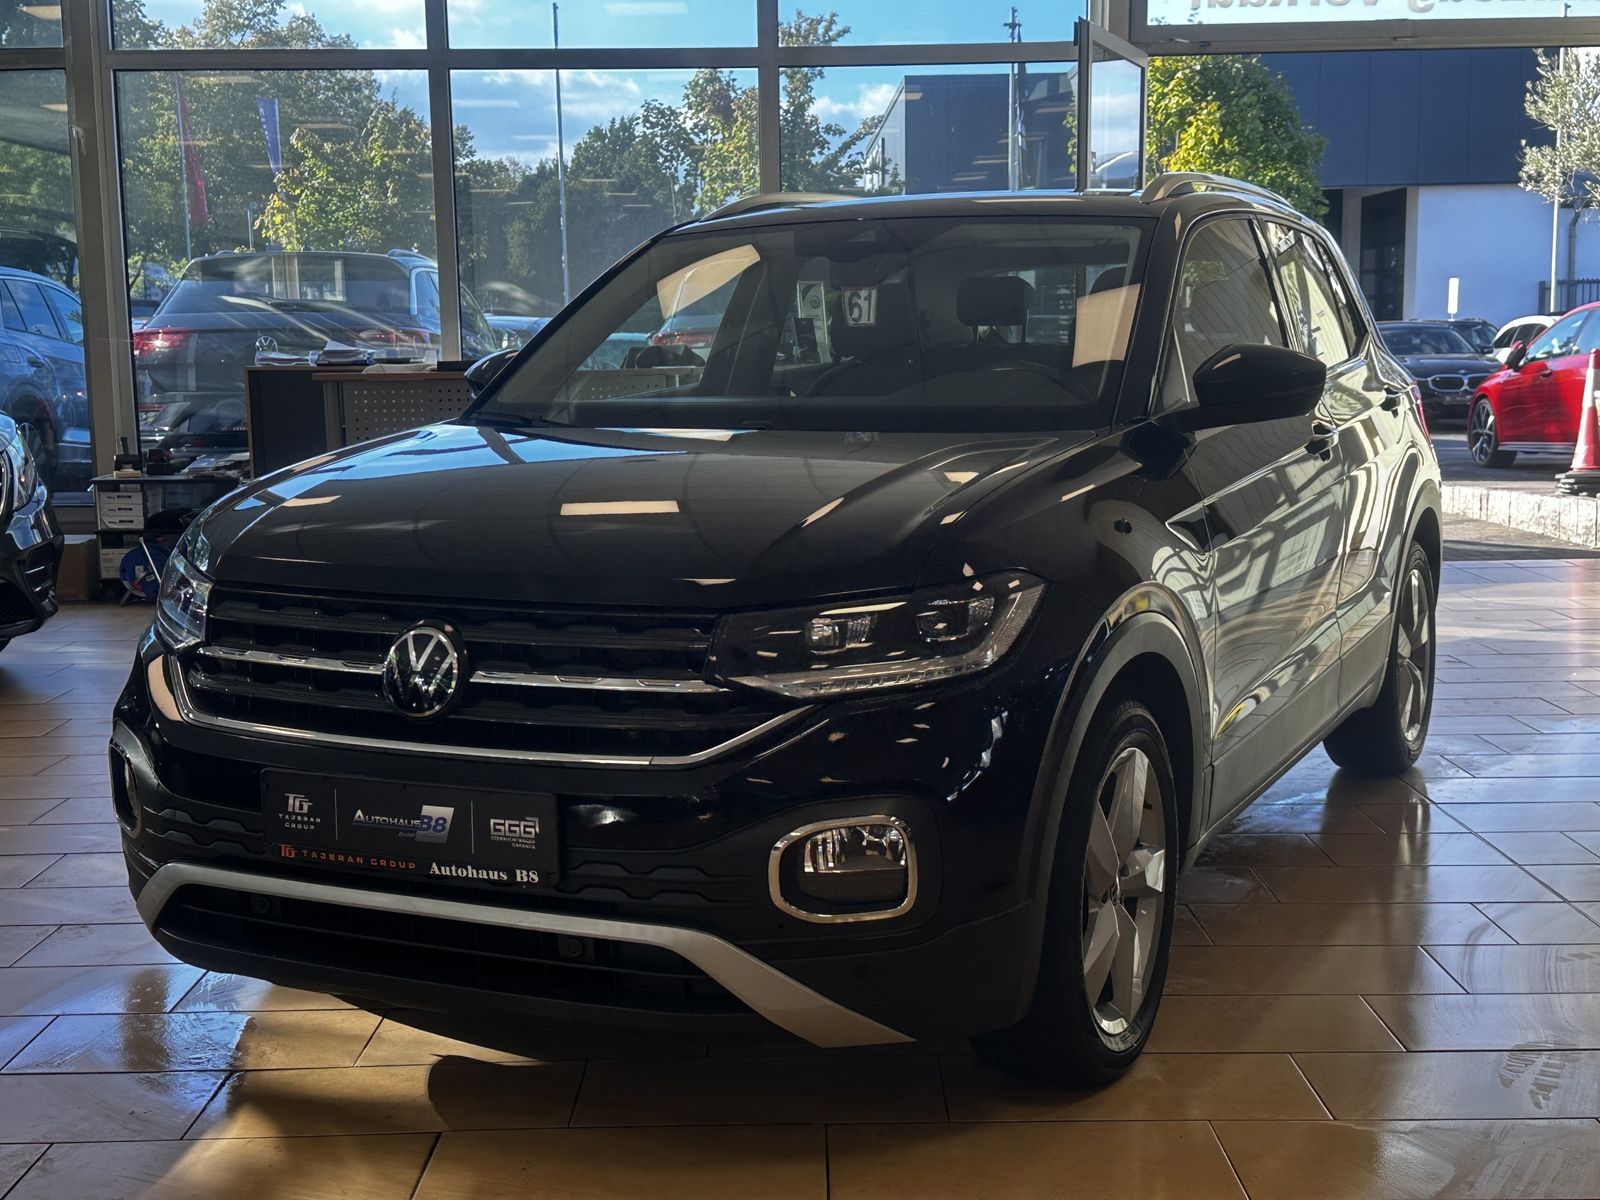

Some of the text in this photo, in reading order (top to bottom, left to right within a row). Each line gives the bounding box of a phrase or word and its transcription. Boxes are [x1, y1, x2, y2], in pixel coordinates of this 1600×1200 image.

[370, 858, 417, 870] GROUP
[429, 862, 540, 883] Autohaus B8
